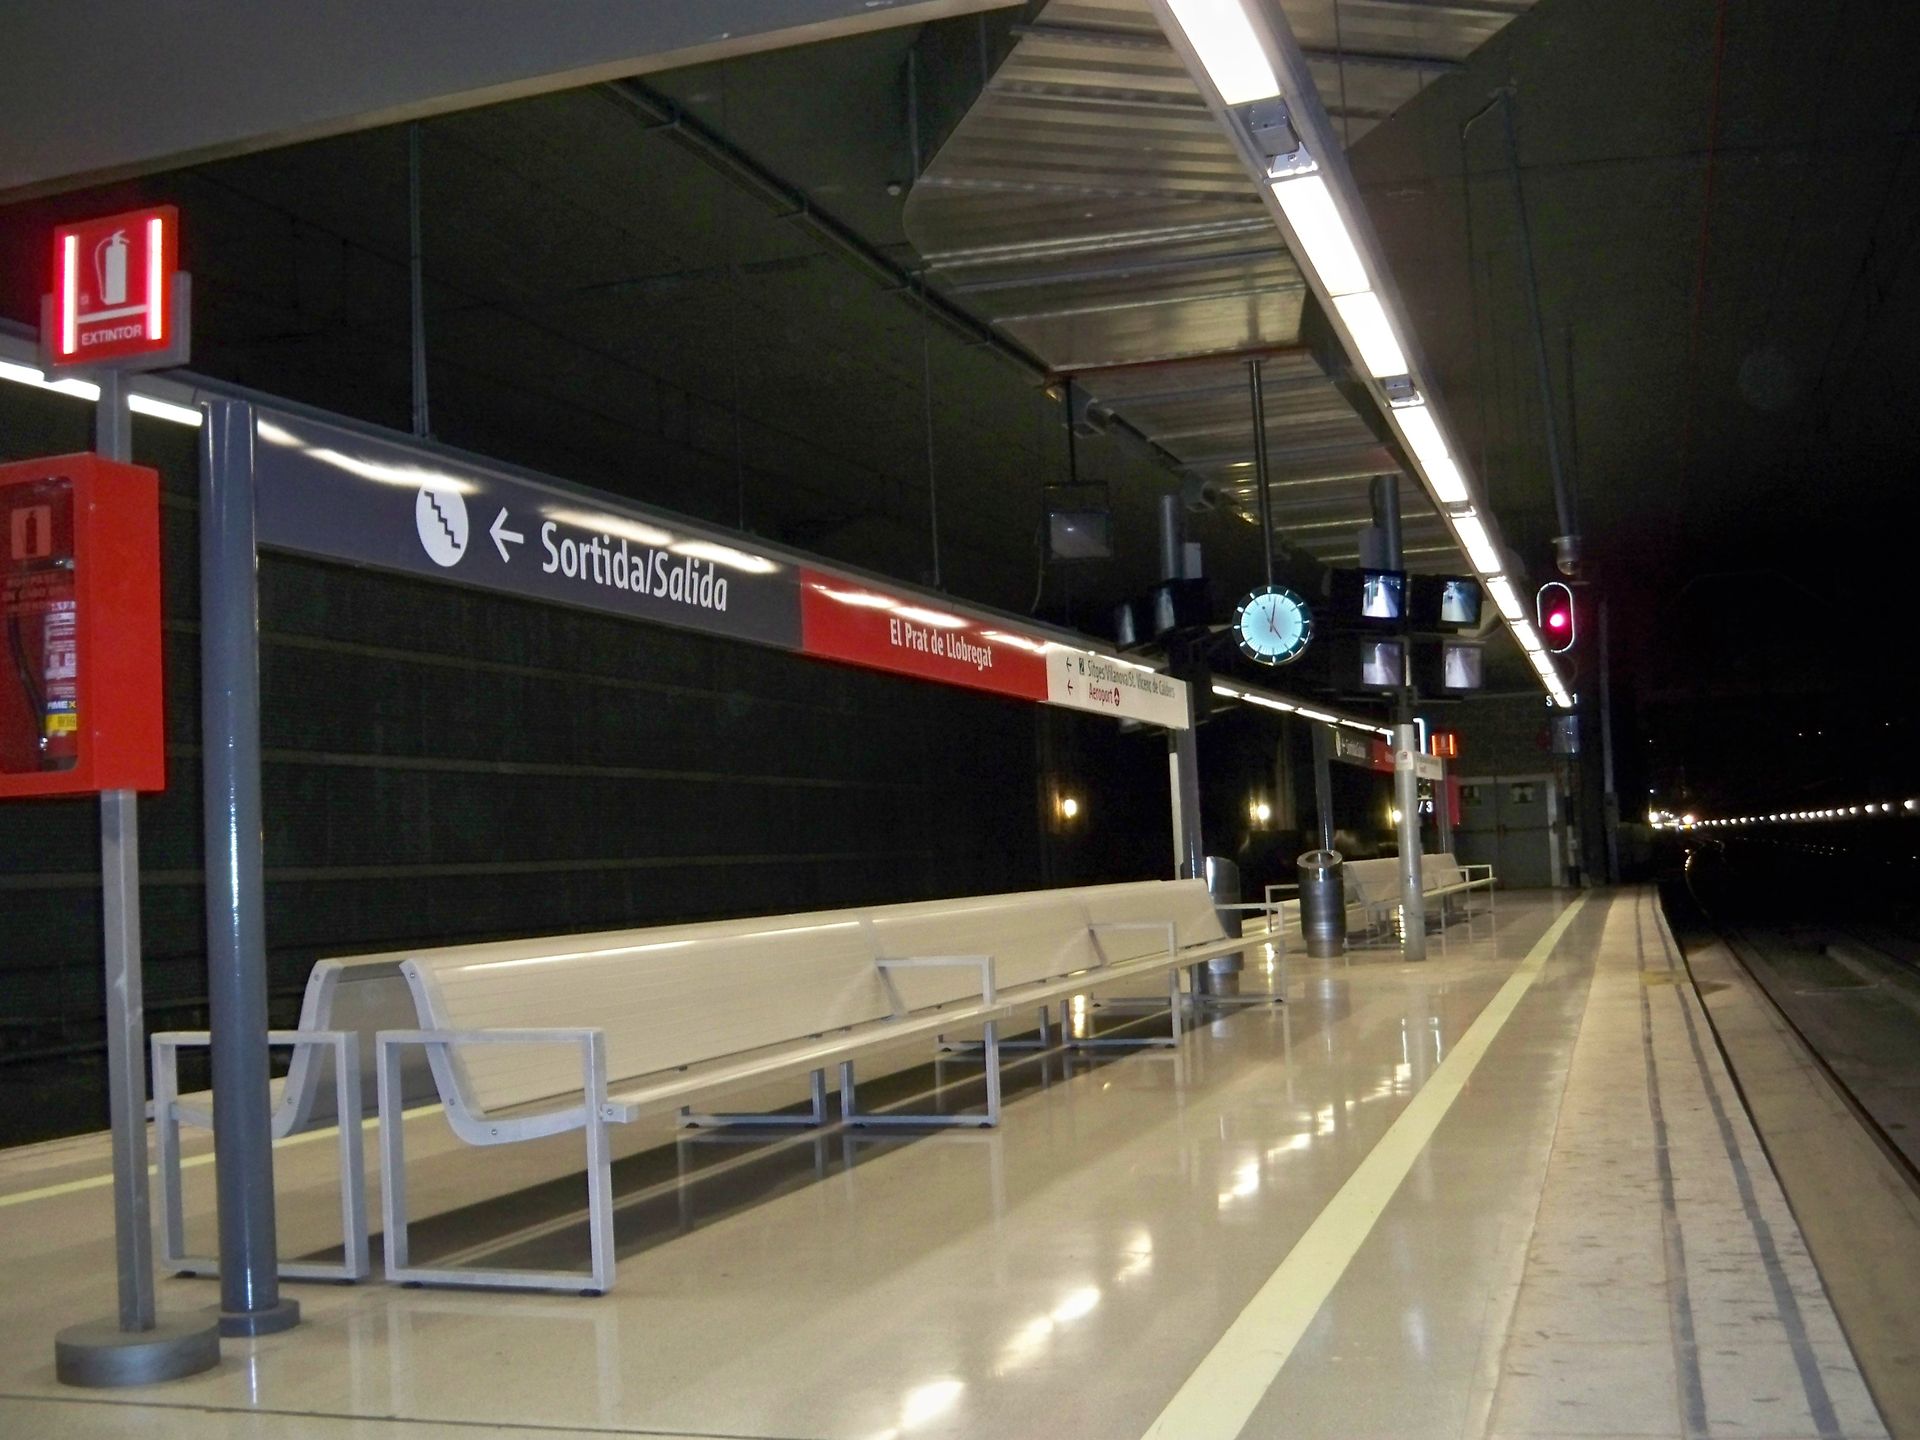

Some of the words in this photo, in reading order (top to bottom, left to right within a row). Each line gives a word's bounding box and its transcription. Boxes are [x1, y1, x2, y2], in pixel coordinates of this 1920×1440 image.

[81, 325, 142, 346] EXTINTOR
[541, 521, 728, 612] Sortida/Salida
[890, 618, 902, 647] El
[904, 622, 929, 653] Prat
[931, 628, 944, 656] de
[946, 632, 993, 672] Llobregat
[1088, 682, 1114, 706] Aeroport
[1426, 801, 1433, 813] 3
